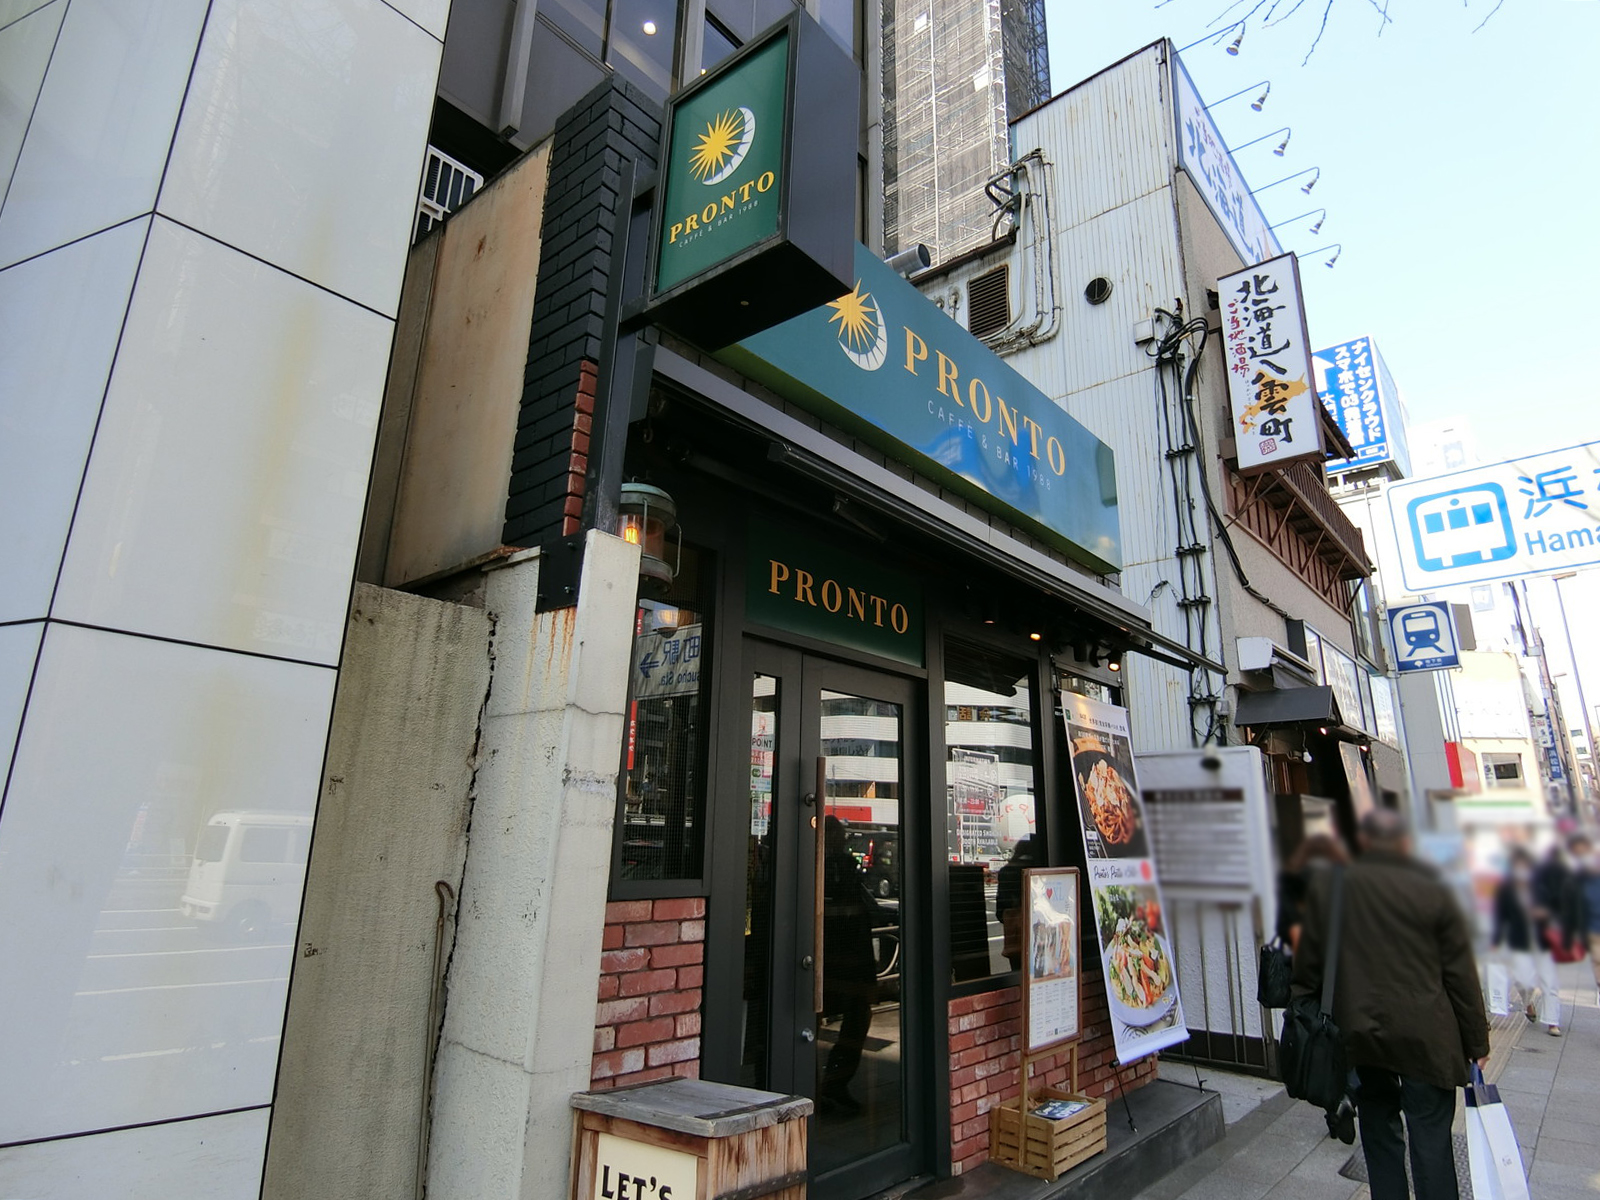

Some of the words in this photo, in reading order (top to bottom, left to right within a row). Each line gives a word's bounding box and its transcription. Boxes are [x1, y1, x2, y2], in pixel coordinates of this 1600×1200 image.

[669, 171, 775, 244] PRONTO
[717, 213, 734, 227] BAR
[739, 199, 759, 215] 1988
[1227, 298, 1251, 378] ご当地酒場
[1236, 274, 1293, 443] 北海道八雲町
[903, 325, 1066, 476] PRONTO
[1351, 341, 1381, 442] ナイセンクラウド
[981, 434, 989, 449] &
[996, 446, 1019, 469] BAR
[1026, 464, 1051, 491] 1988
[1517, 465, 1600, 520] 浜
[1524, 525, 1600, 556] Ham
[768, 559, 910, 634] PRONTO
[751, 737, 773, 749] POINT
